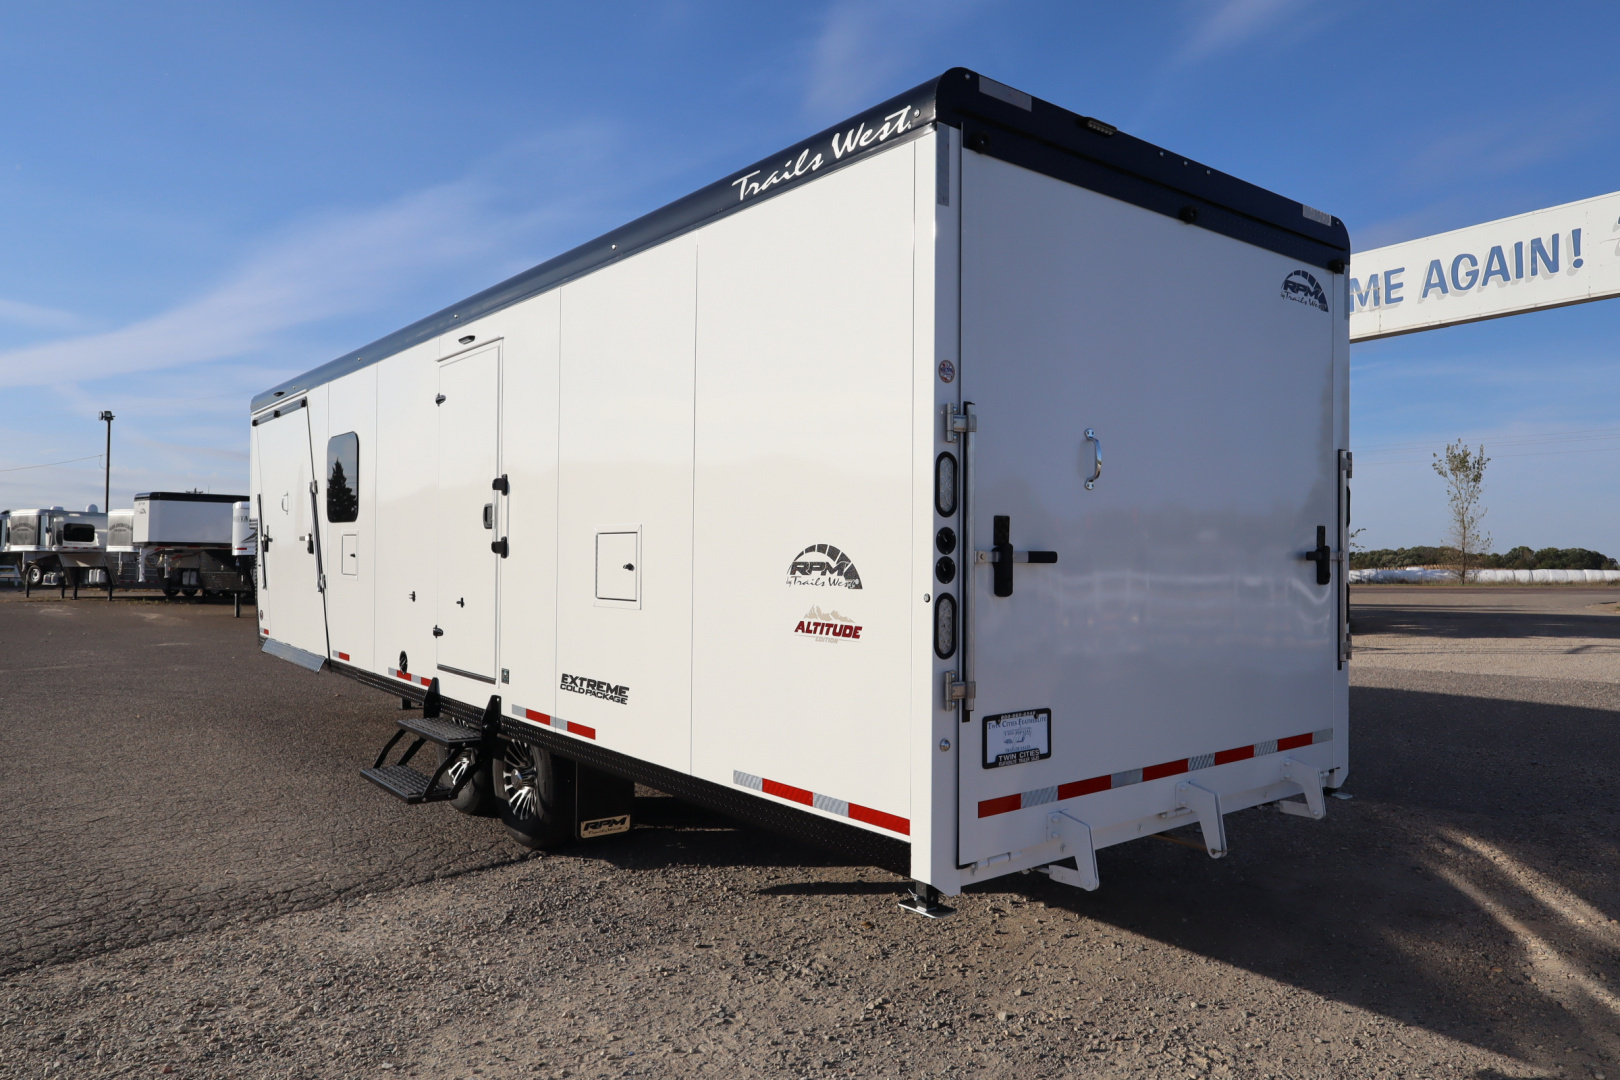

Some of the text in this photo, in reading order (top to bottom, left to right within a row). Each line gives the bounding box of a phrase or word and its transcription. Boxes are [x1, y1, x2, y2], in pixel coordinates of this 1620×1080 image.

[731, 105, 911, 201] Trails West
[1421, 228, 1584, 299] AGAIN!
[1283, 280, 1323, 301] RPM
[789, 561, 849, 577] RPM
[790, 576, 825, 587] Trails
[794, 620, 863, 640] ALTITUDE
[561, 673, 630, 698] EXTREME
[999, 753, 1017, 761] TWIN
[1019, 750, 1039, 758] CITIES
[583, 817, 627, 831] RPM
